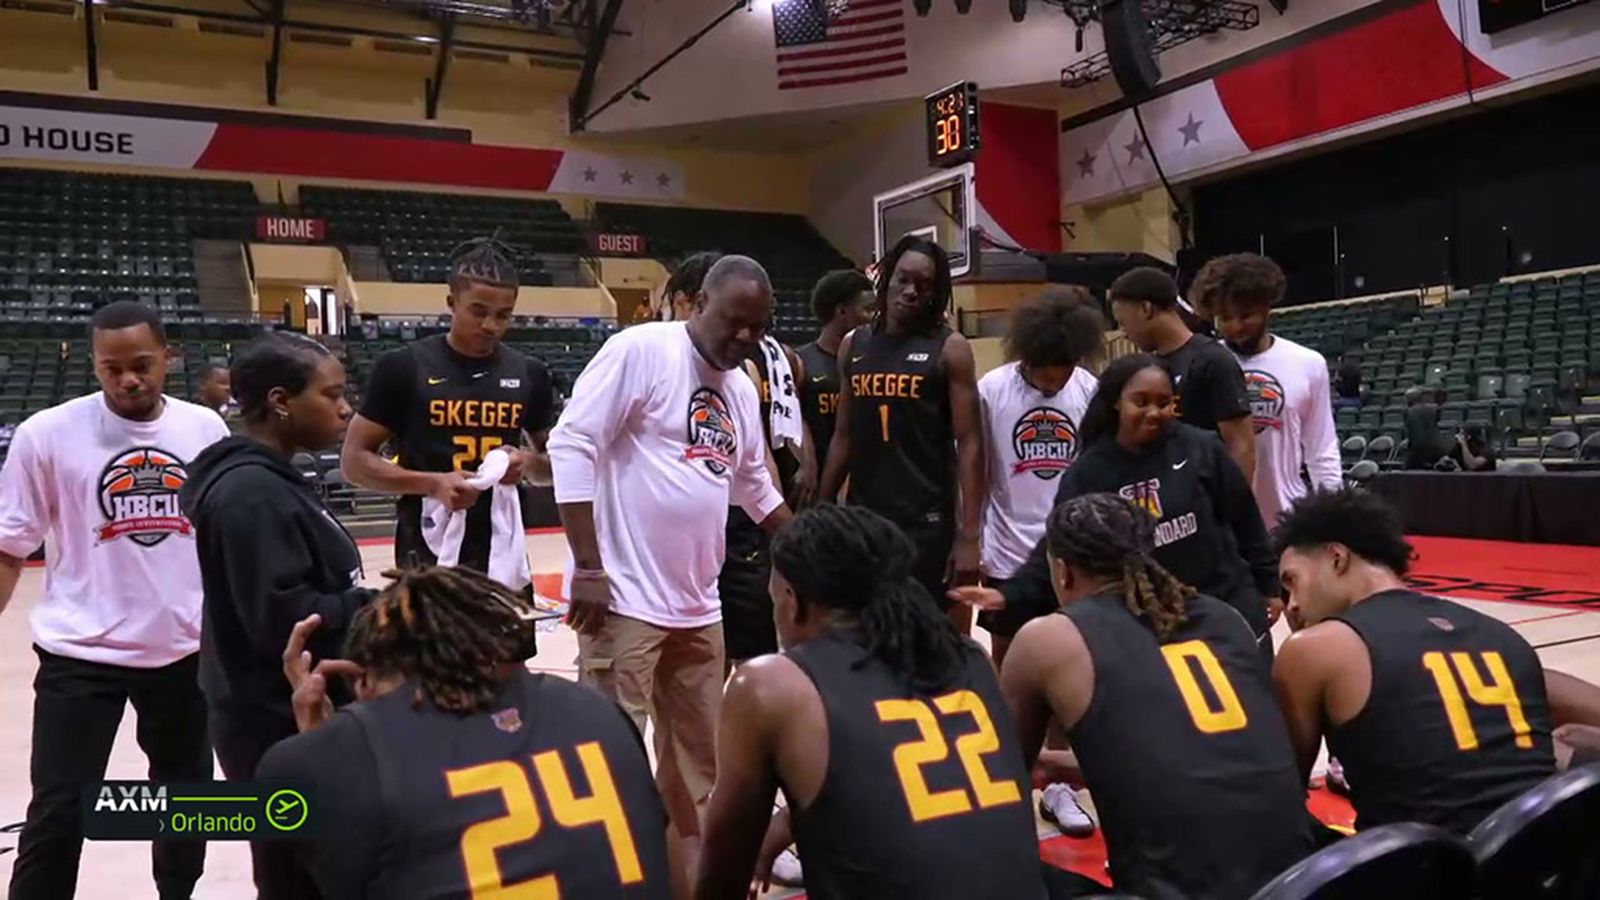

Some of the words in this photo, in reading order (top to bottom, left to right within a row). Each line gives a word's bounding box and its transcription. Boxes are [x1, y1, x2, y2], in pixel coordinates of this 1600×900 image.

[22, 125, 135, 155] HOUSE
[936, 114, 960, 155] 30
[266, 217, 315, 239] HOME
[598, 234, 640, 253] GUEST
[850, 373, 925, 399] SKEGEE
[429, 399, 523, 429] SKEGEE
[879, 404, 890, 442] 1
[112, 493, 180, 521] HBCU
[1160, 639, 1248, 734] 0
[1422, 651, 1533, 750] 14
[874, 689, 1022, 823] 22
[445, 741, 644, 900] 24
